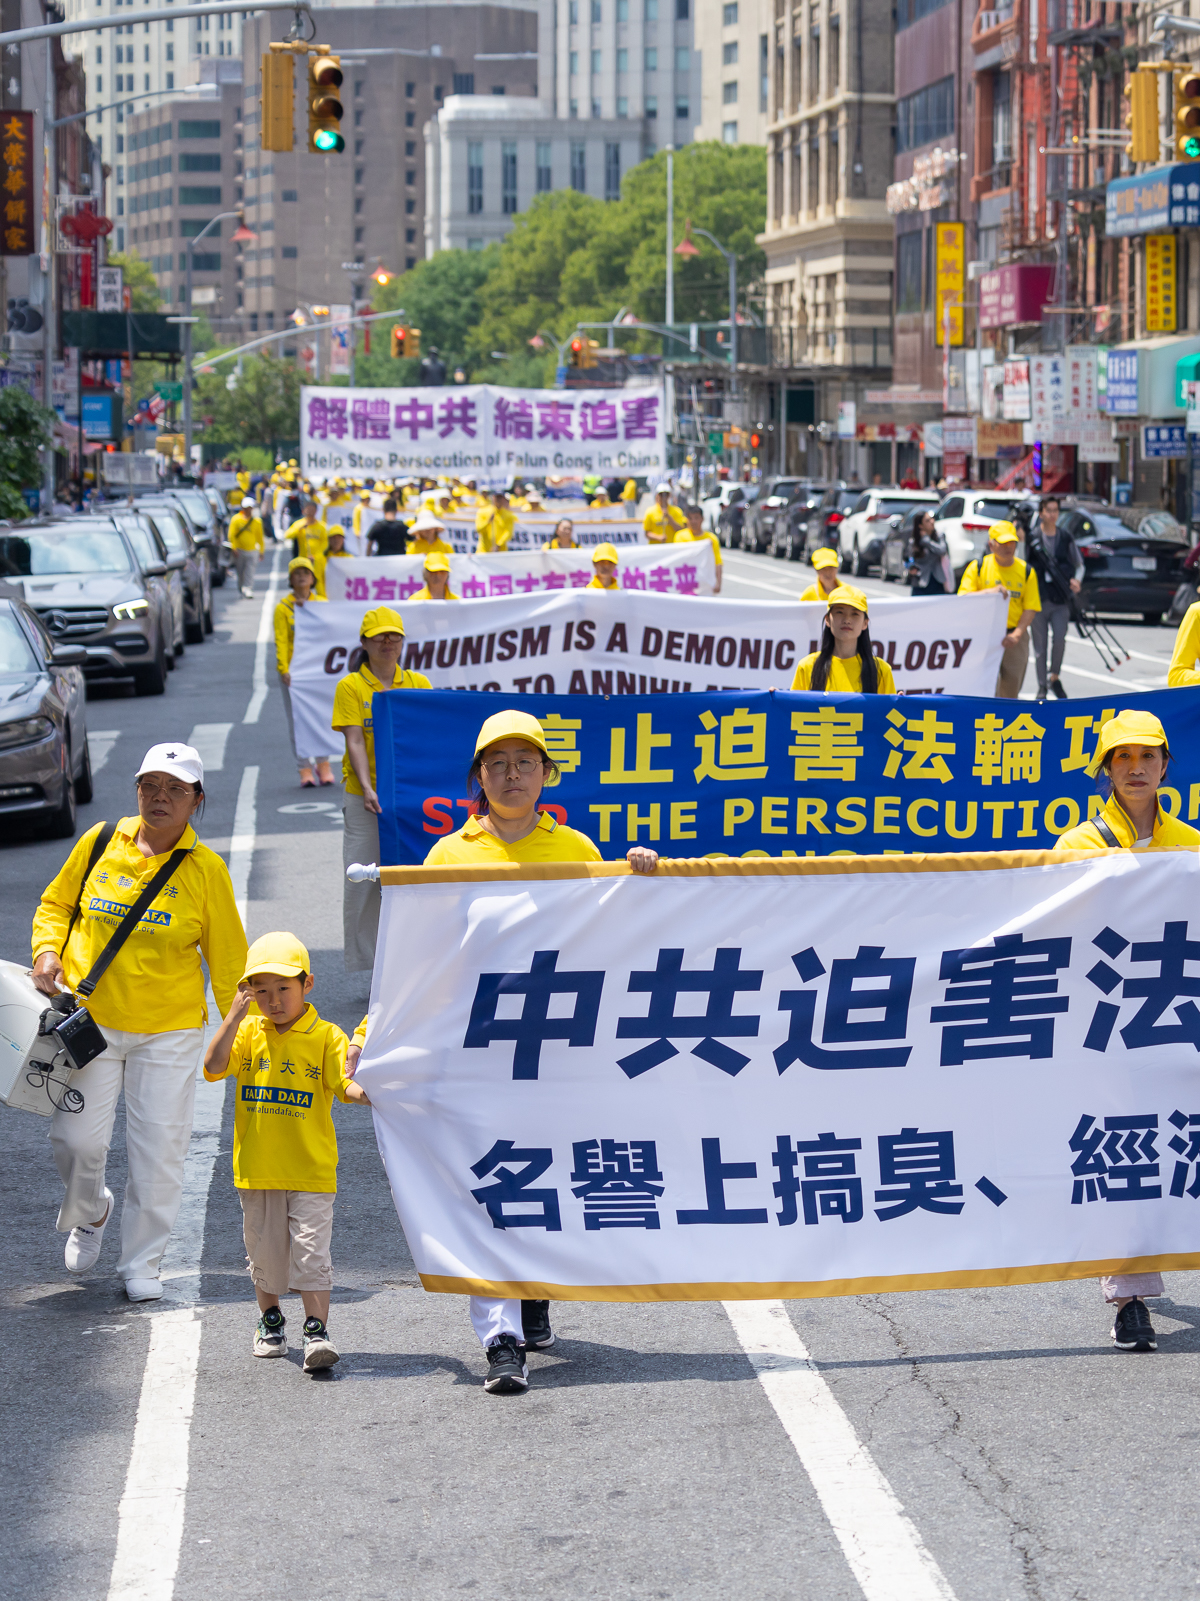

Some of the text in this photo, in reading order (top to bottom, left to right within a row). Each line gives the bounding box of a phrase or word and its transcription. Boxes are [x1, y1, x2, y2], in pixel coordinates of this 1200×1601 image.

[308, 397, 659, 441] 解體中共 結束迫害
[307, 450, 661, 471] Help Stop Persecution of Falun Gong in China
[577, 531, 639, 546] JUDICIARY
[324, 624, 552, 675] COMUNISM
[562, 619, 597, 653] IS
[605, 621, 629, 654] A
[640, 625, 796, 671] DEMONIC
[588, 802, 698, 842] THE
[90, 899, 169, 925] FALUN AFA
[277, 1090, 310, 1106] DAFA
